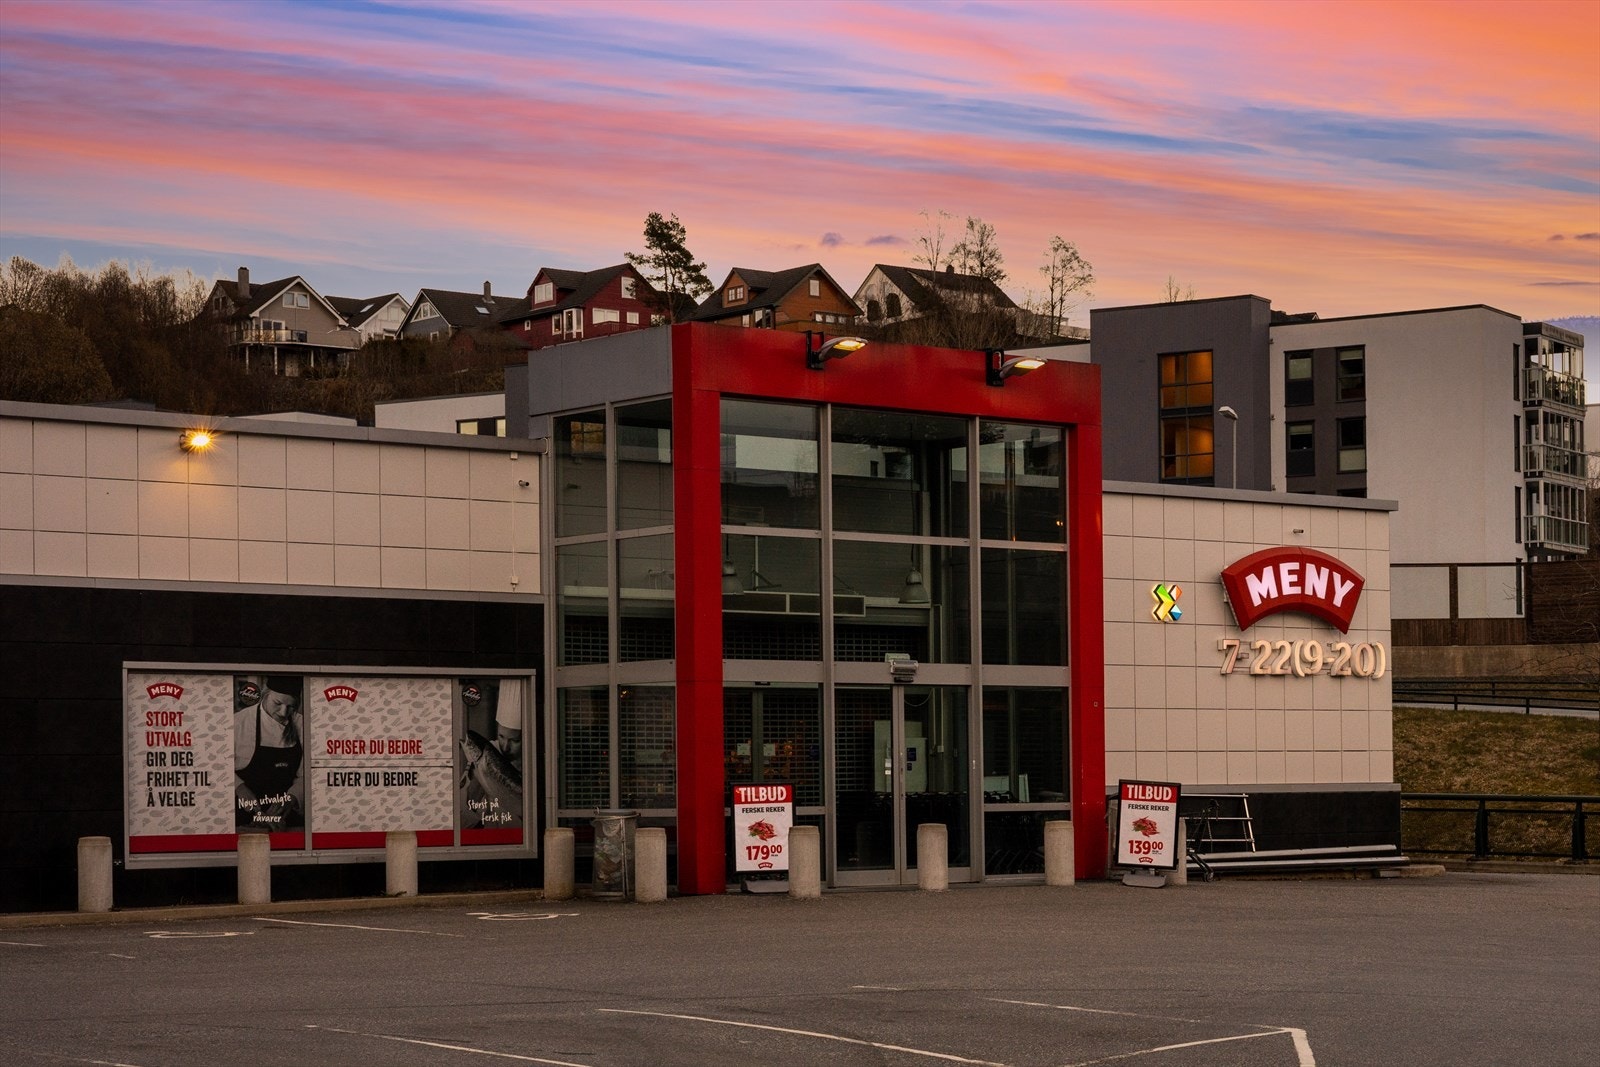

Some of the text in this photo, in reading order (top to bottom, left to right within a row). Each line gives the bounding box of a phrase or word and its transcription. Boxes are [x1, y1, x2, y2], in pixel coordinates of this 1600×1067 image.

[1245, 562, 1355, 608] MENY
[1217, 638, 1386, 680] 7-22(9-20)
[151, 685, 180, 696] MENY
[328, 688, 354, 699] MENY
[146, 711, 184, 727] STORT
[146, 731, 192, 747] UTVALG
[326, 739, 423, 755] SPISER DU BEDRE
[146, 751, 194, 767] GIR DEG
[147, 771, 211, 787] FRIHET TIL
[327, 771, 418, 787] LEVER DU BEDRE
[147, 787, 196, 807] Å VELGE
[738, 786, 787, 802] TILBUD
[1127, 785, 1172, 800] TILBUD
[238, 791, 292, 811] Nøye utvalgte
[468, 798, 499, 811] Størst på
[1128, 803, 1170, 812] FERSKE REKER
[253, 811, 282, 823] råvarer
[481, 812, 512, 825] fersk fisk
